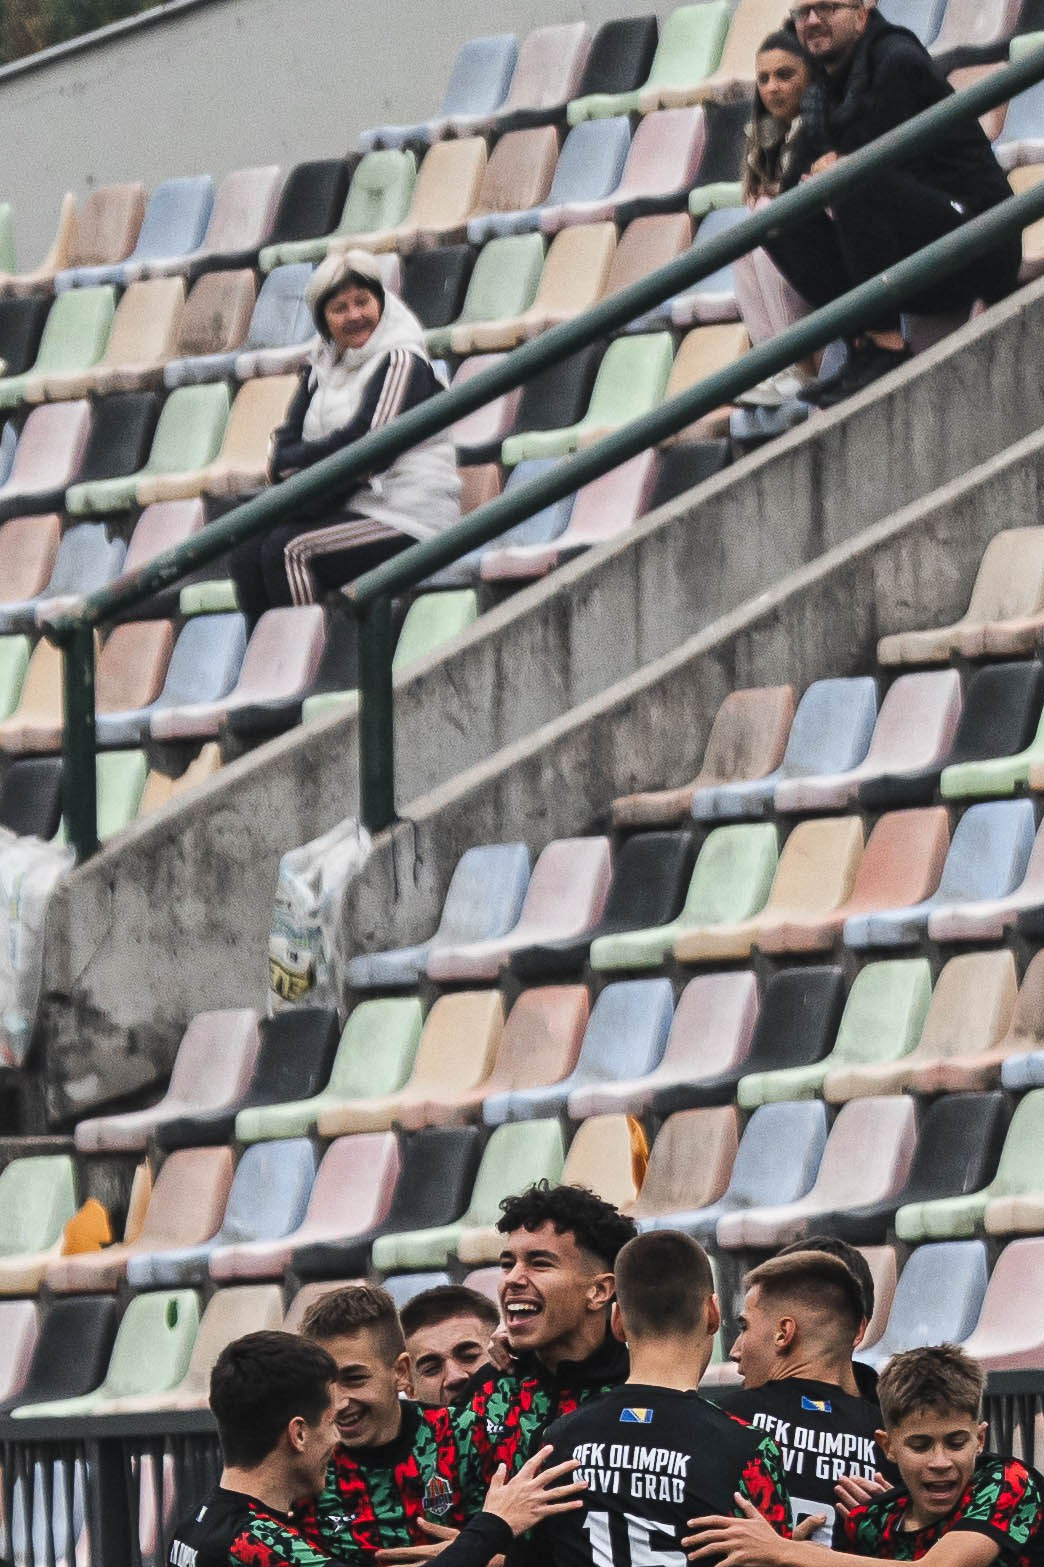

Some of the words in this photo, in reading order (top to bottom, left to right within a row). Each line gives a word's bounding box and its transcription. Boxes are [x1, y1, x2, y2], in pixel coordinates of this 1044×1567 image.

[609, 1444, 692, 1479] OLIMPIK
[794, 1426, 877, 1466] OLIMPIK
[630, 1473, 686, 1504] GRAD
